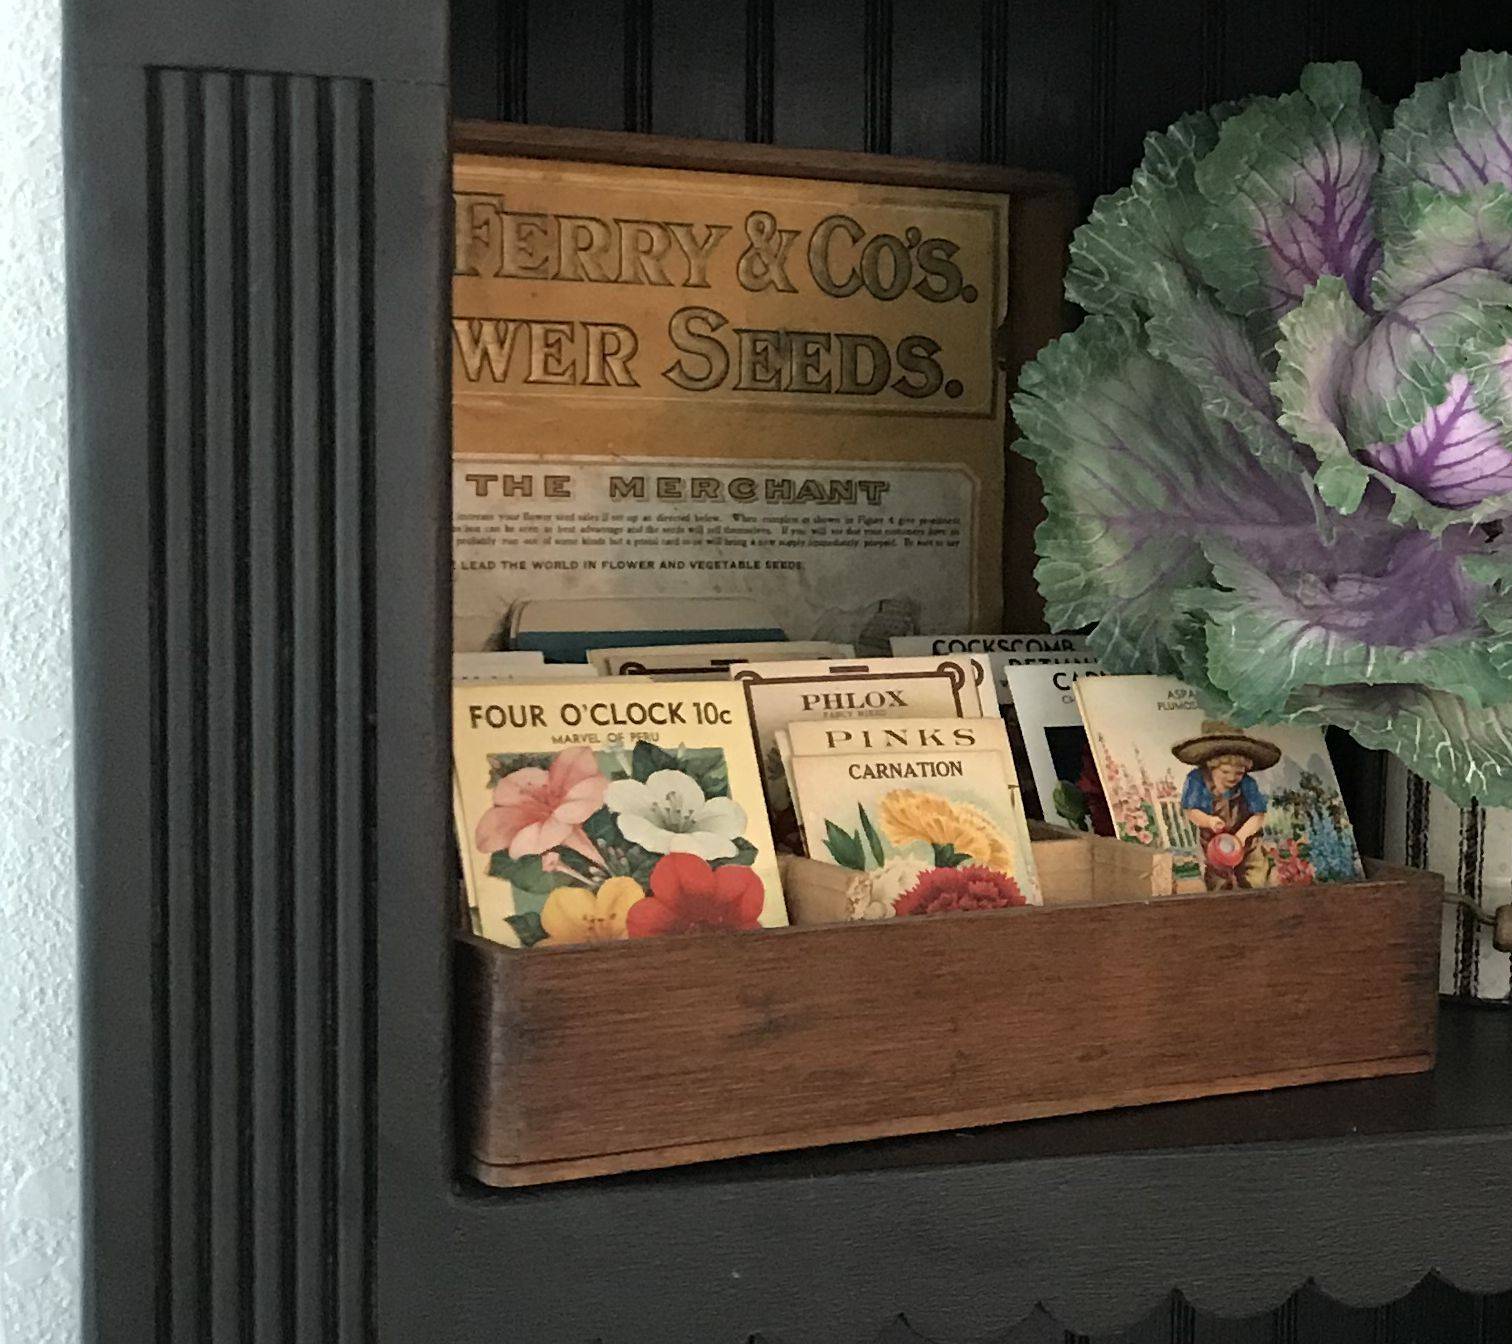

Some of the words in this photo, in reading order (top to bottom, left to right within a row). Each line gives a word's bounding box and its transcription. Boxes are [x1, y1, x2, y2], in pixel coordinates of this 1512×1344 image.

[465, 473, 573, 499] THE
[608, 475, 891, 505] MERCHANT
[461, 559, 497, 570] LEAD
[499, 559, 528, 570] THE
[531, 559, 580, 570] WORLD
[582, 559, 598, 570] IN
[600, 559, 656, 570] FLOWER
[658, 559, 687, 570] AND
[688, 559, 761, 570] VEGETABLE
[800, 690, 910, 712] PHLOX
[468, 704, 547, 729] FOUR
[560, 702, 687, 727] O'CLOCK
[693, 702, 733, 725] 10c
[551, 733, 601, 744] MARVEL
[606, 732, 625, 743] OF
[630, 731, 660, 743] PERU
[825, 728, 977, 749] PINKS
[849, 760, 963, 780] CARNATION
